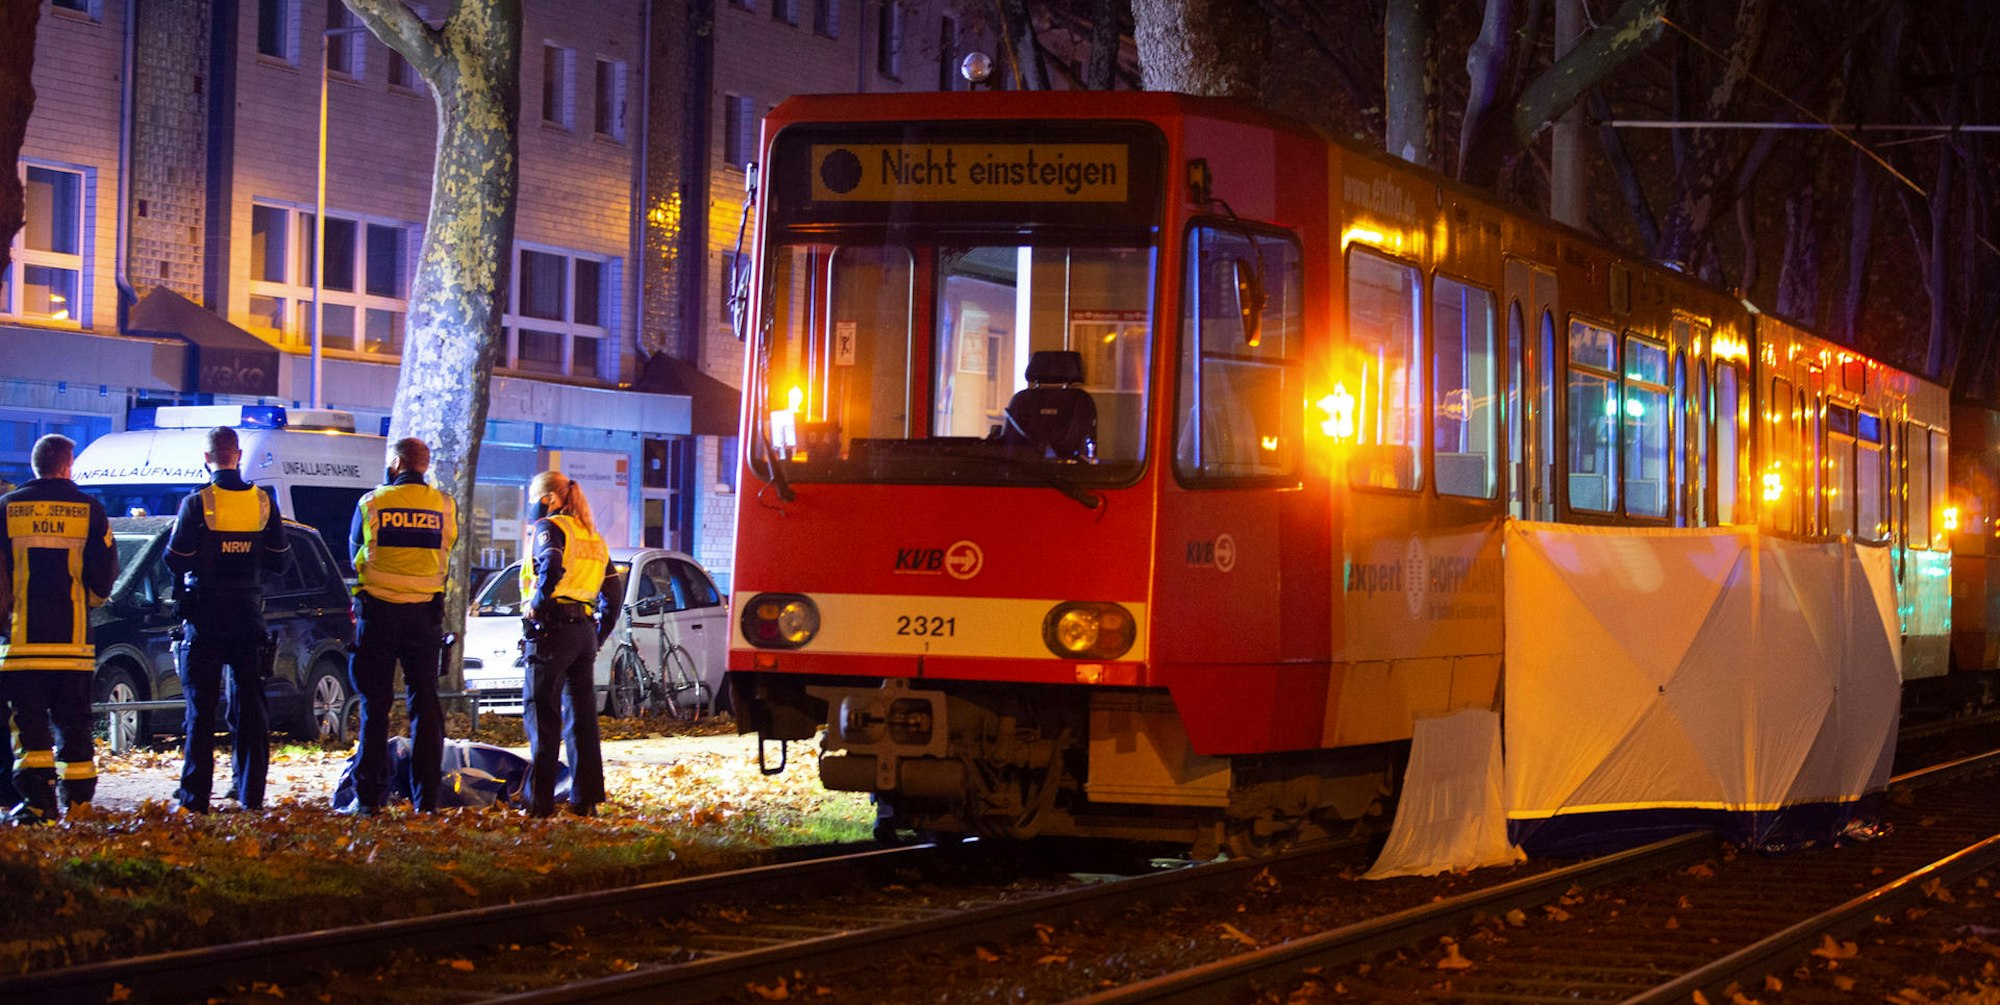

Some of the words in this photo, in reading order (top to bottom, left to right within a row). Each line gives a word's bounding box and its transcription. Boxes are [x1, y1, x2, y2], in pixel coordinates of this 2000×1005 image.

[881, 148, 957, 185] Nicht
[969, 148, 1117, 194] einsteigen
[282, 460, 361, 478] UNFALLAUFNAHME
[32, 517, 65, 534] KÖLN
[381, 511, 441, 530] POLIZEI
[221, 540, 252, 553] NRW
[1186, 541, 1215, 564] KVB
[895, 547, 944, 571] KVB
[1347, 559, 1401, 600] expert
[1429, 556, 1497, 594] HOFFMANN
[896, 615, 956, 637] 2321
